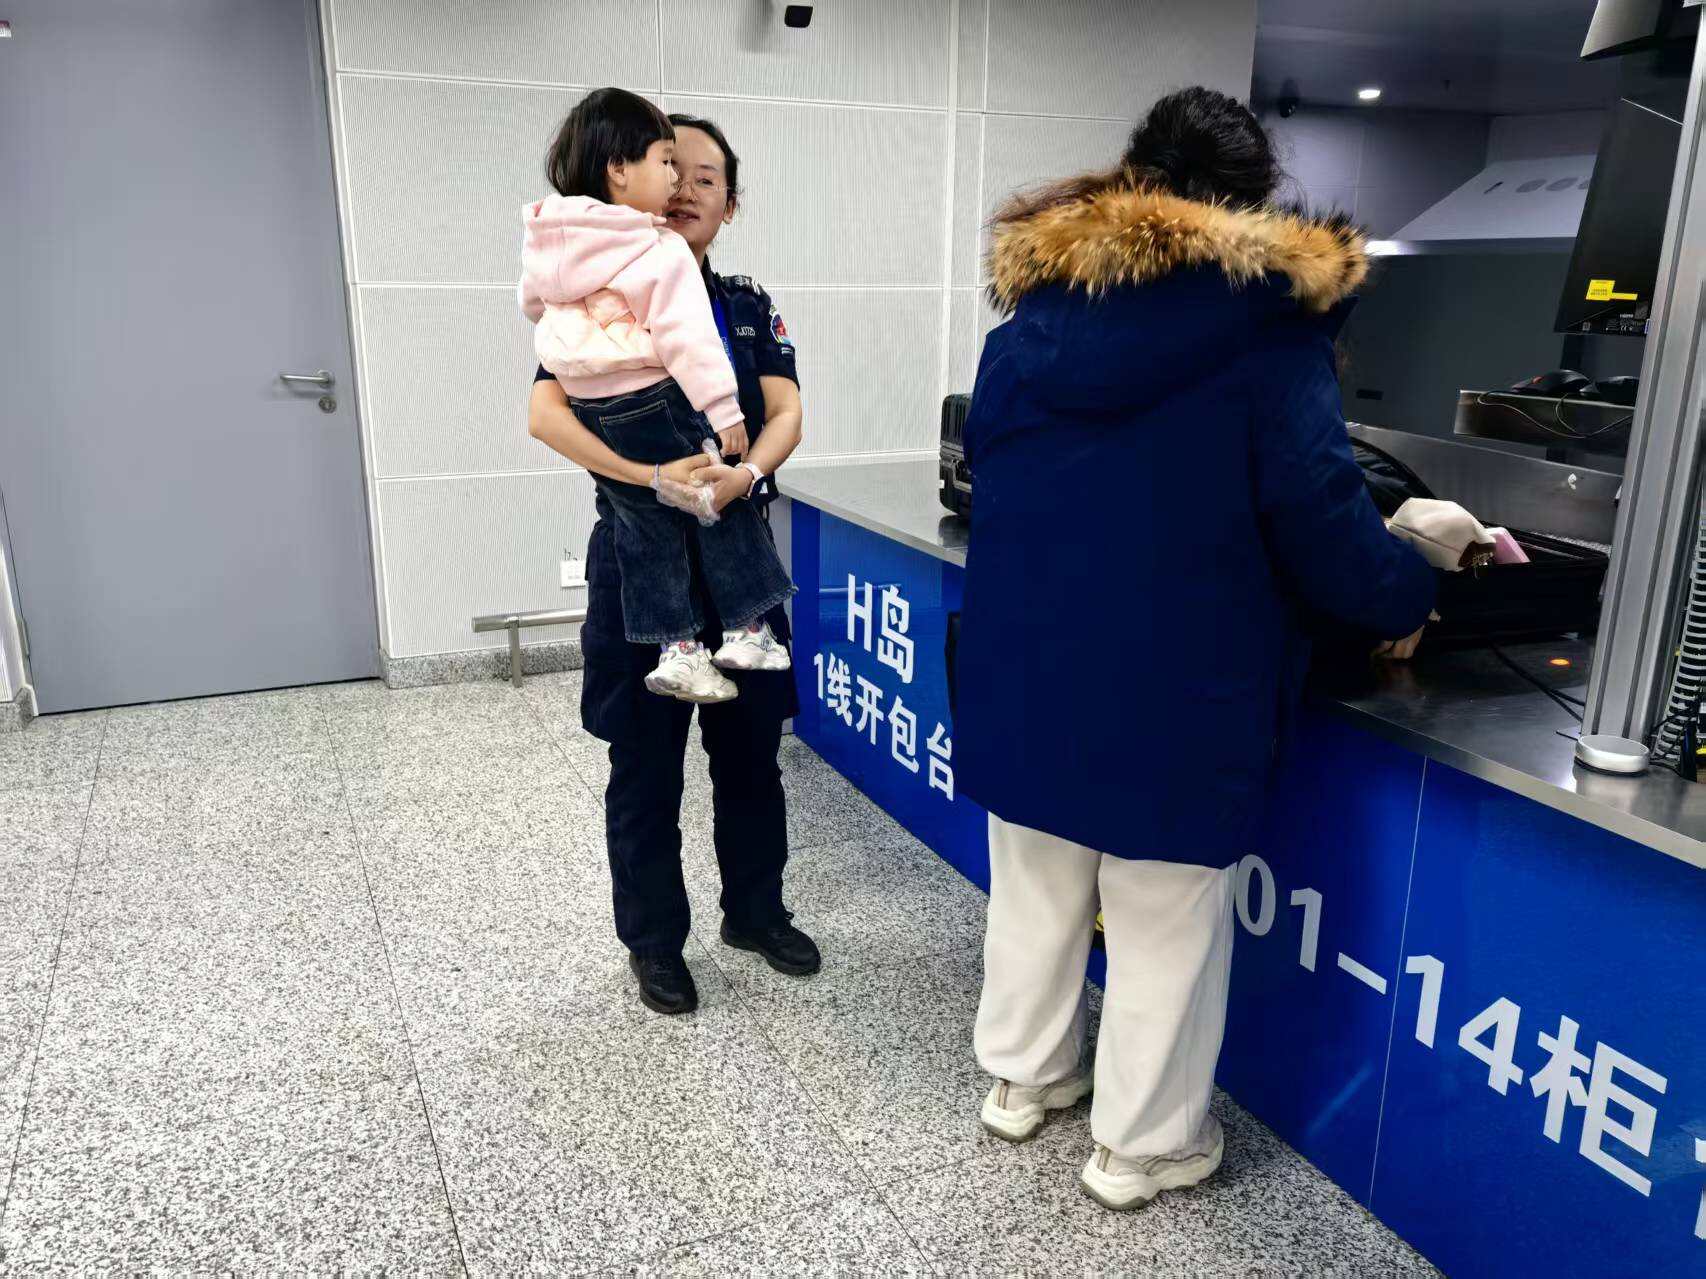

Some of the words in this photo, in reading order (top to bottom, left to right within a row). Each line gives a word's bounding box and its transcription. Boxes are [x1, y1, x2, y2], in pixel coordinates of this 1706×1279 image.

[847, 573, 915, 684] H岛
[813, 652, 955, 802] 1线开包台
[1235, 854, 1706, 1240] 01-14柜
